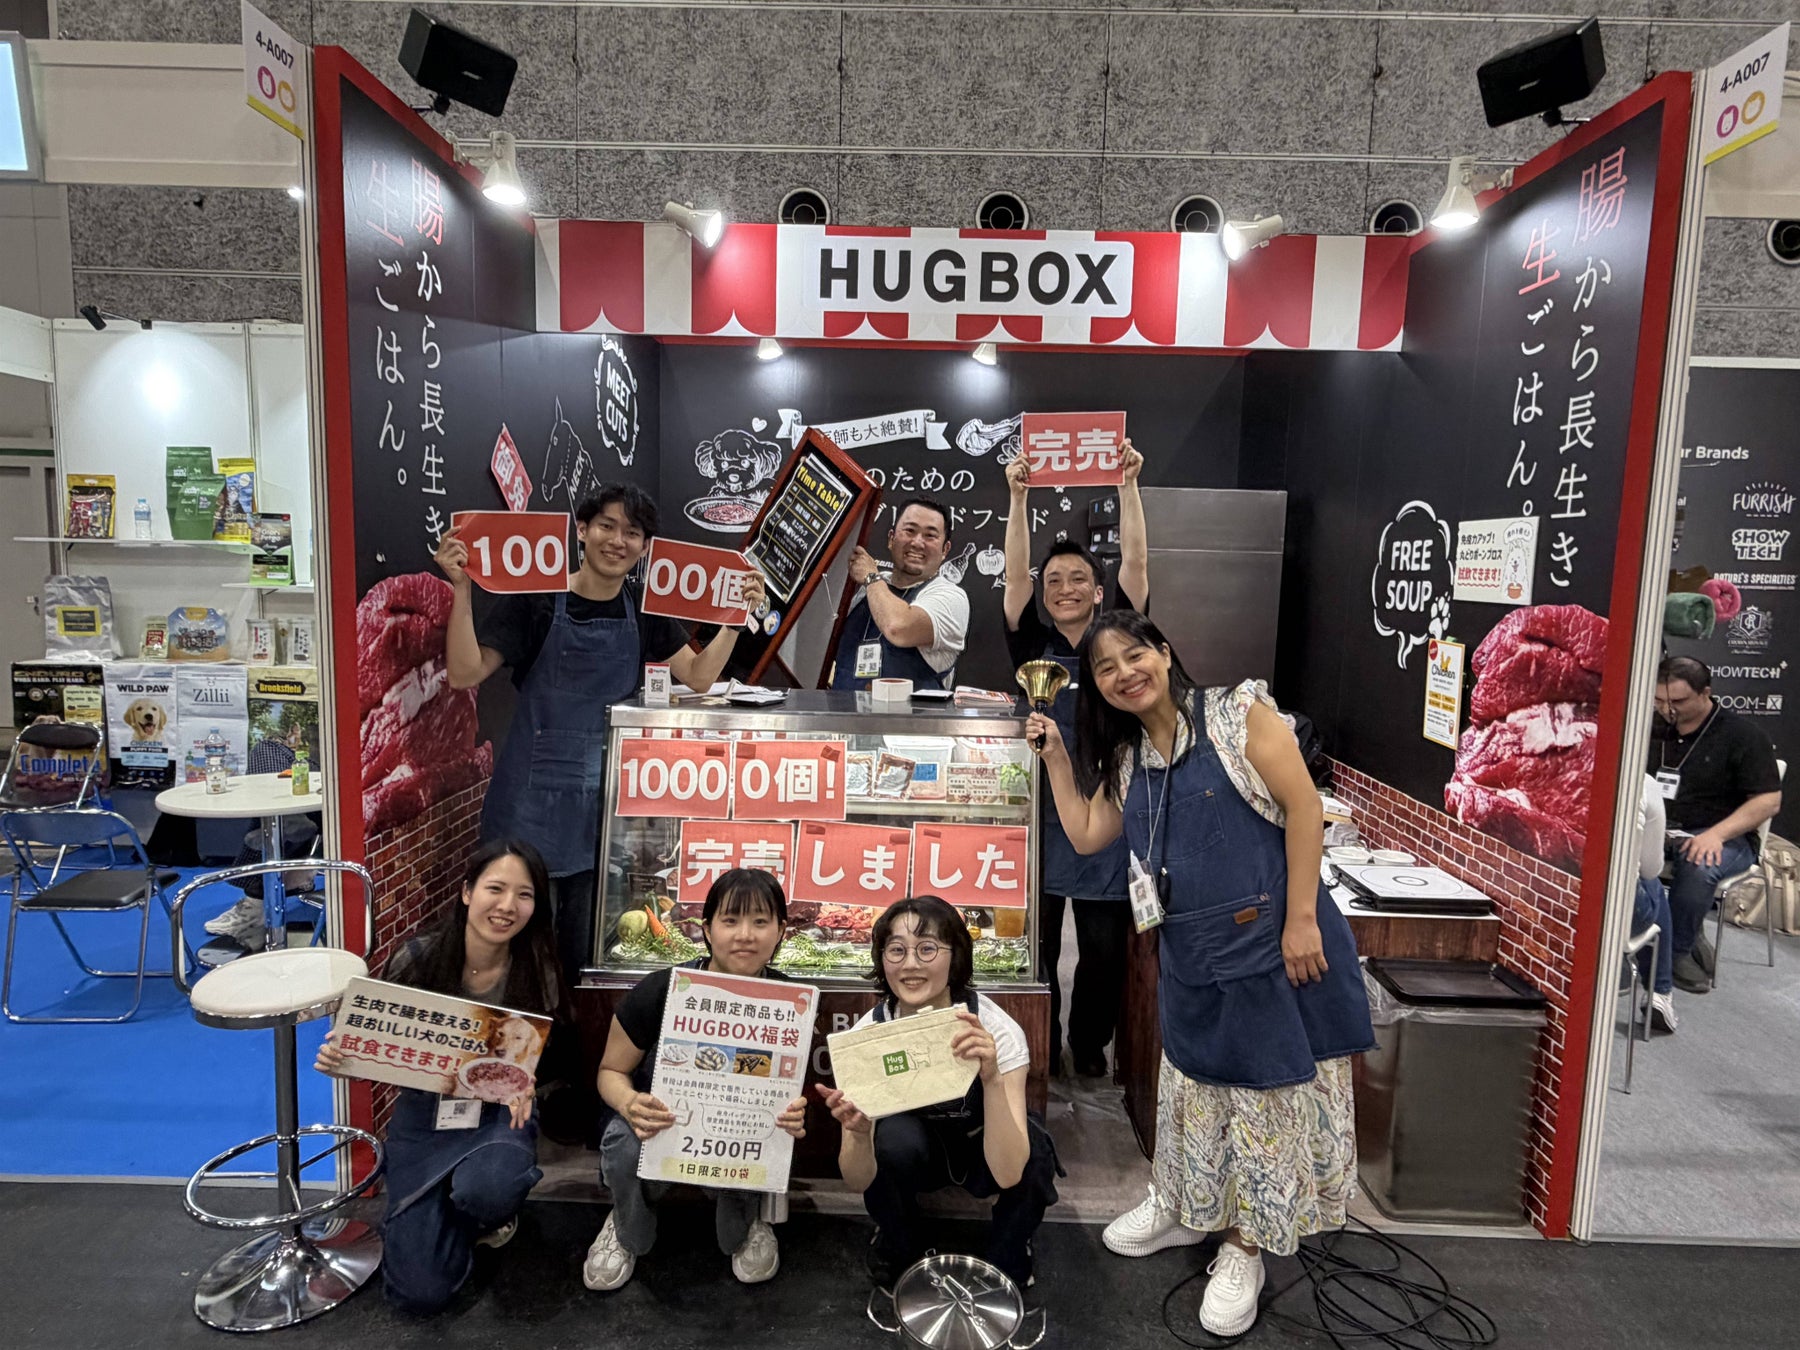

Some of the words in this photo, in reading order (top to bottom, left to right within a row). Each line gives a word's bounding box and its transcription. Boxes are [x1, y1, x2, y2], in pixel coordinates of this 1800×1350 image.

[255, 30, 294, 69] 4-A007
[1720, 52, 1771, 95] 4-A007
[819, 248, 1118, 306] HUGBOX
[365, 159, 406, 486] 生ごはん。
[1506, 219, 1561, 517] 生ごはん。
[1549, 146, 1628, 588] 腸から長生き
[606, 361, 631, 412] MEET
[605, 398, 628, 442] CUTS
[1029, 428, 1119, 472] 完売
[1695, 446, 1749, 459] Brands
[796, 465, 816, 492] Time
[1733, 491, 1797, 514] FURRISH
[1732, 529, 1790, 546] SHOW
[1734, 545, 1783, 561] TECH
[473, 535, 564, 576] 100
[1391, 539, 1433, 572] FREE
[649, 558, 749, 611] 00個
[1385, 579, 1432, 613] SOUP
[1750, 574, 1796, 586] SPECIALTIES
[117, 684, 144, 693] WILD
[146, 684, 169, 694] PAW
[193, 687, 230, 703] Zillii
[20, 753, 101, 779] Complete
[351, 994, 481, 1034] 生肉で腸を整える!
[345, 1013, 489, 1054] 超おいしい犬のごはん
[673, 1015, 800, 1048] HUGBOX福袋
[340, 1034, 463, 1073] 試食できます!
[886, 1054, 905, 1067] Hug
[887, 1063, 906, 1074] Box
[681, 1136, 763, 1161] 2,500円
[679, 1163, 750, 1180] 1日限定10袋
